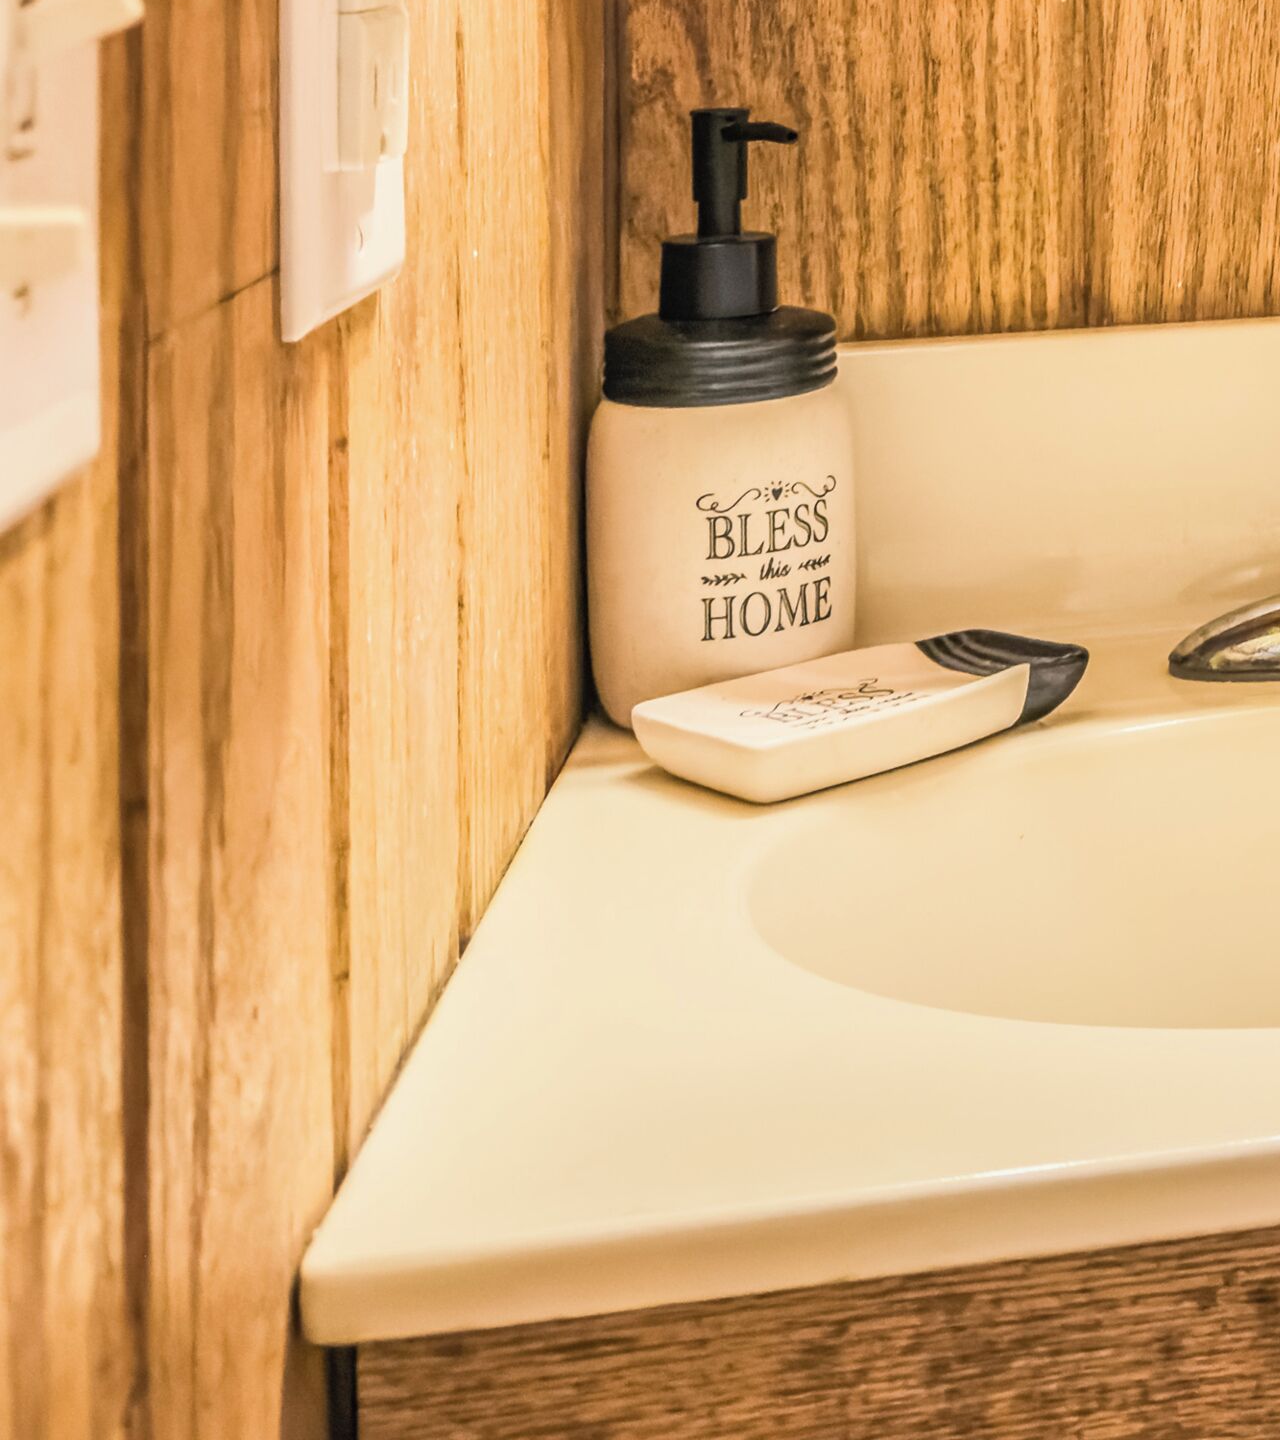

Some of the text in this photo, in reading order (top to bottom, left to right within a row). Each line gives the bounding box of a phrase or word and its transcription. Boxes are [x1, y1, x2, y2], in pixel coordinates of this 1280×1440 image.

[705, 498, 829, 560] BLESS
[759, 557, 792, 581] this
[701, 576, 833, 642] HOME
